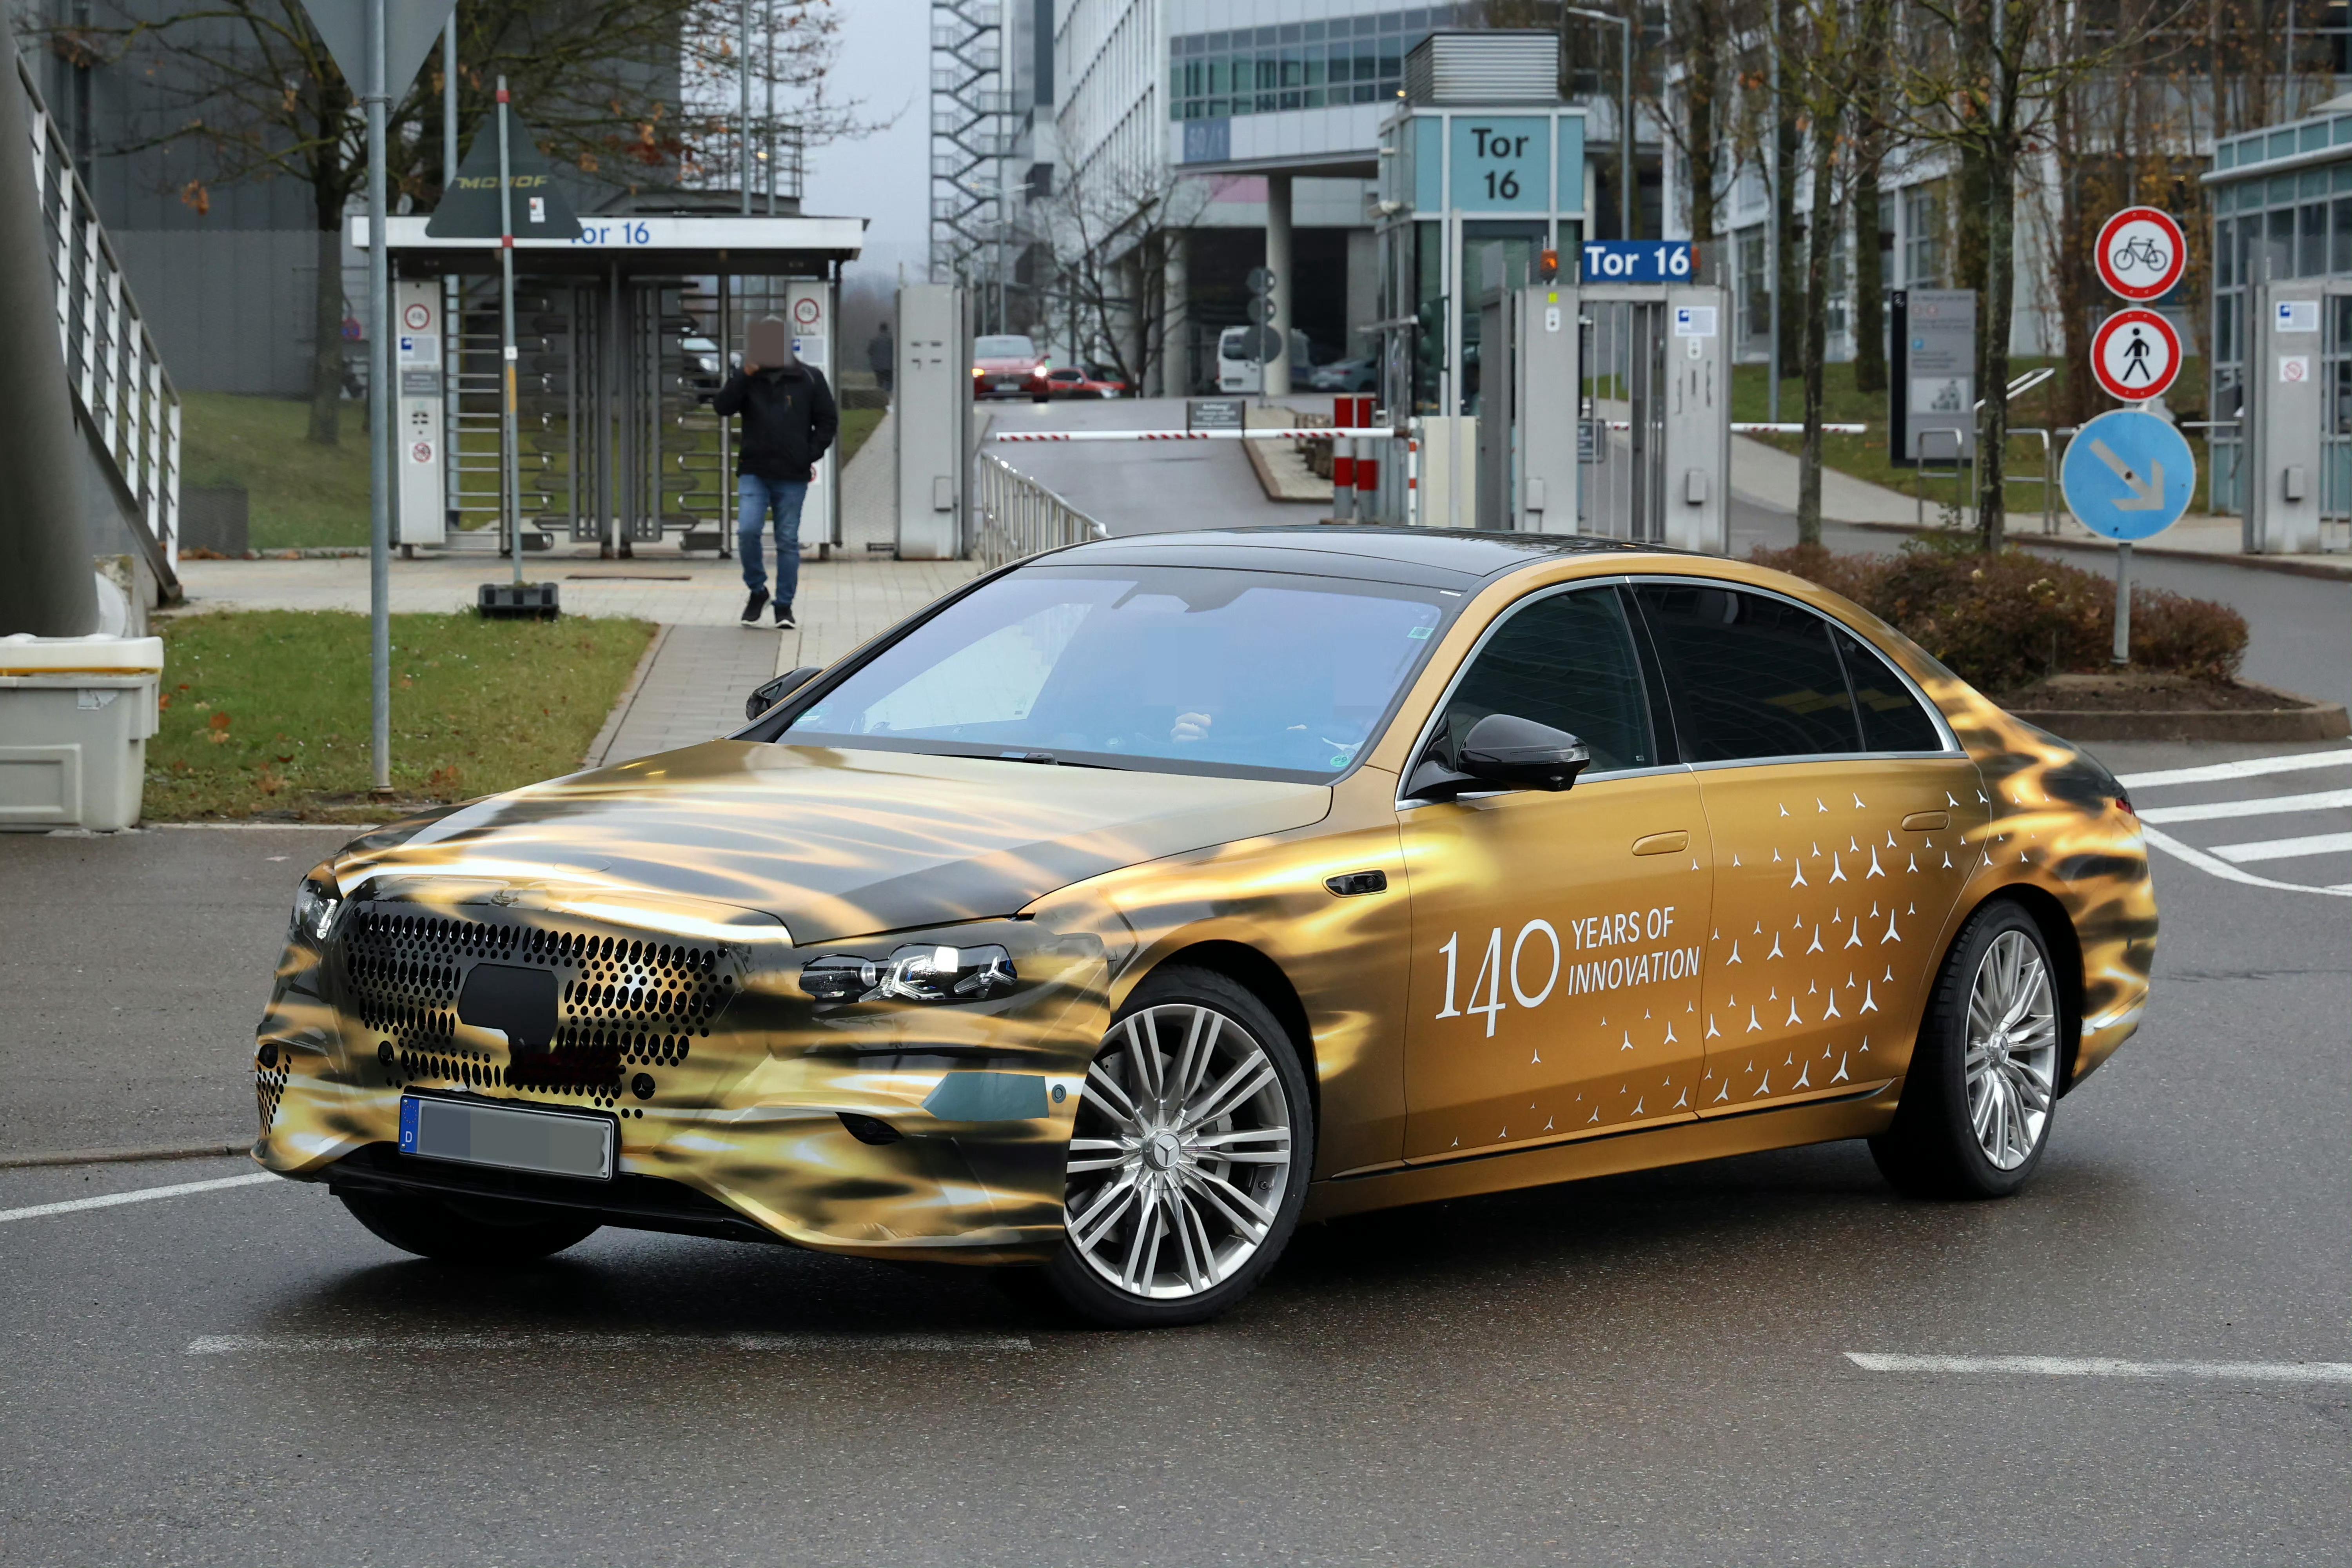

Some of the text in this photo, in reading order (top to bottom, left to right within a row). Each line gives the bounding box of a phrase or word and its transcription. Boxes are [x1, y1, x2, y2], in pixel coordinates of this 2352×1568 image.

[1471, 128, 1529, 158] Tor
[1485, 170, 1519, 200] 16
[571, 221, 650, 244] or 16
[1584, 246, 1690, 276] Tor 16
[1571, 906, 1674, 950] YEARS OF
[1435, 918, 1560, 1038] 140
[1568, 946, 1700, 996] INNOVATION
[405, 1131, 412, 1143] D
